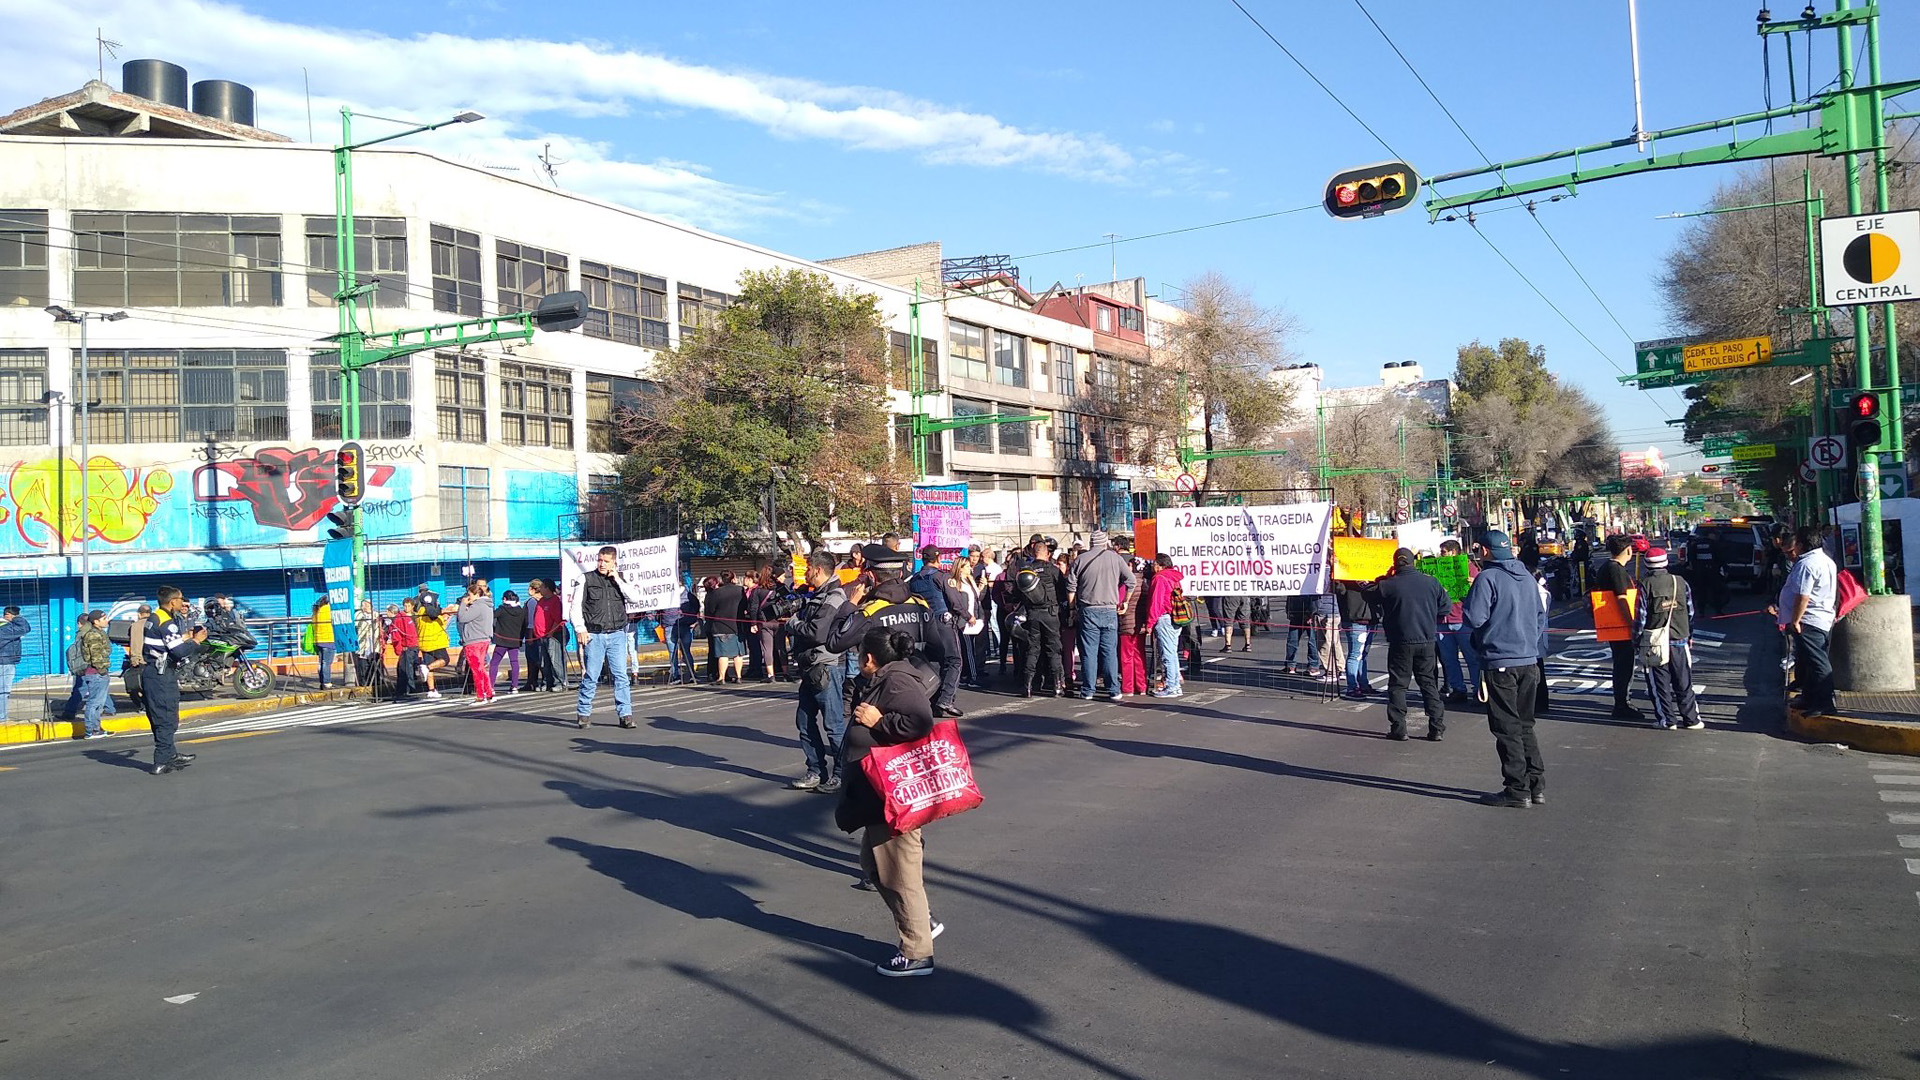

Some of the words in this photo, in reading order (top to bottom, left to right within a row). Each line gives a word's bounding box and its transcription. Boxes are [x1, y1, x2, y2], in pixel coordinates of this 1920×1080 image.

[1856, 217, 1884, 231] EJE
[1836, 285, 1912, 300] CENTRAL
[1685, 347, 1706, 358] CEDA
[1710, 346, 1719, 355] EL
[1722, 343, 1744, 353] PASO
[1687, 359, 1698, 368] AL
[1701, 354, 1745, 366] TROLEBUS
[926, 490, 963, 502] LOCATARIOS
[1175, 518, 1182, 527] A
[1184, 513, 1192, 527] 2
[1195, 514, 1223, 527] AÑOS
[1227, 515, 1240, 526] DE
[1243, 515, 1254, 526] LA
[1258, 513, 1313, 525] TRAGEDIA
[1211, 532, 1225, 542] los
[1228, 531, 1274, 542] locatarios
[576, 551, 583, 563] 2
[628, 545, 667, 558] TRAGEDIA
[1170, 546, 1190, 557] DEL
[1192, 545, 1243, 557] MERCADO
[1246, 546, 1251, 556] #
[1254, 545, 1265, 556] 18
[1271, 543, 1321, 555] HIDALGO
[638, 568, 672, 580] HIDALGO
[1174, 564, 1197, 576] ona
[1201, 560, 1273, 576] EXIGIMOS
[1277, 563, 1321, 575] NUESTR
[643, 583, 675, 596] NUESTRA
[1190, 580, 1230, 591] FUENTE
[1233, 580, 1247, 591] DE
[1250, 579, 1301, 591] TRABAJO
[329, 588, 349, 604] PASO
[625, 598, 658, 609] TRABAJO
[880, 612, 930, 627] TRANSIO
[885, 747, 922, 771] VERDURAS
[895, 748, 951, 779] TERE
[894, 768, 967, 805] GABRIELISIMO
